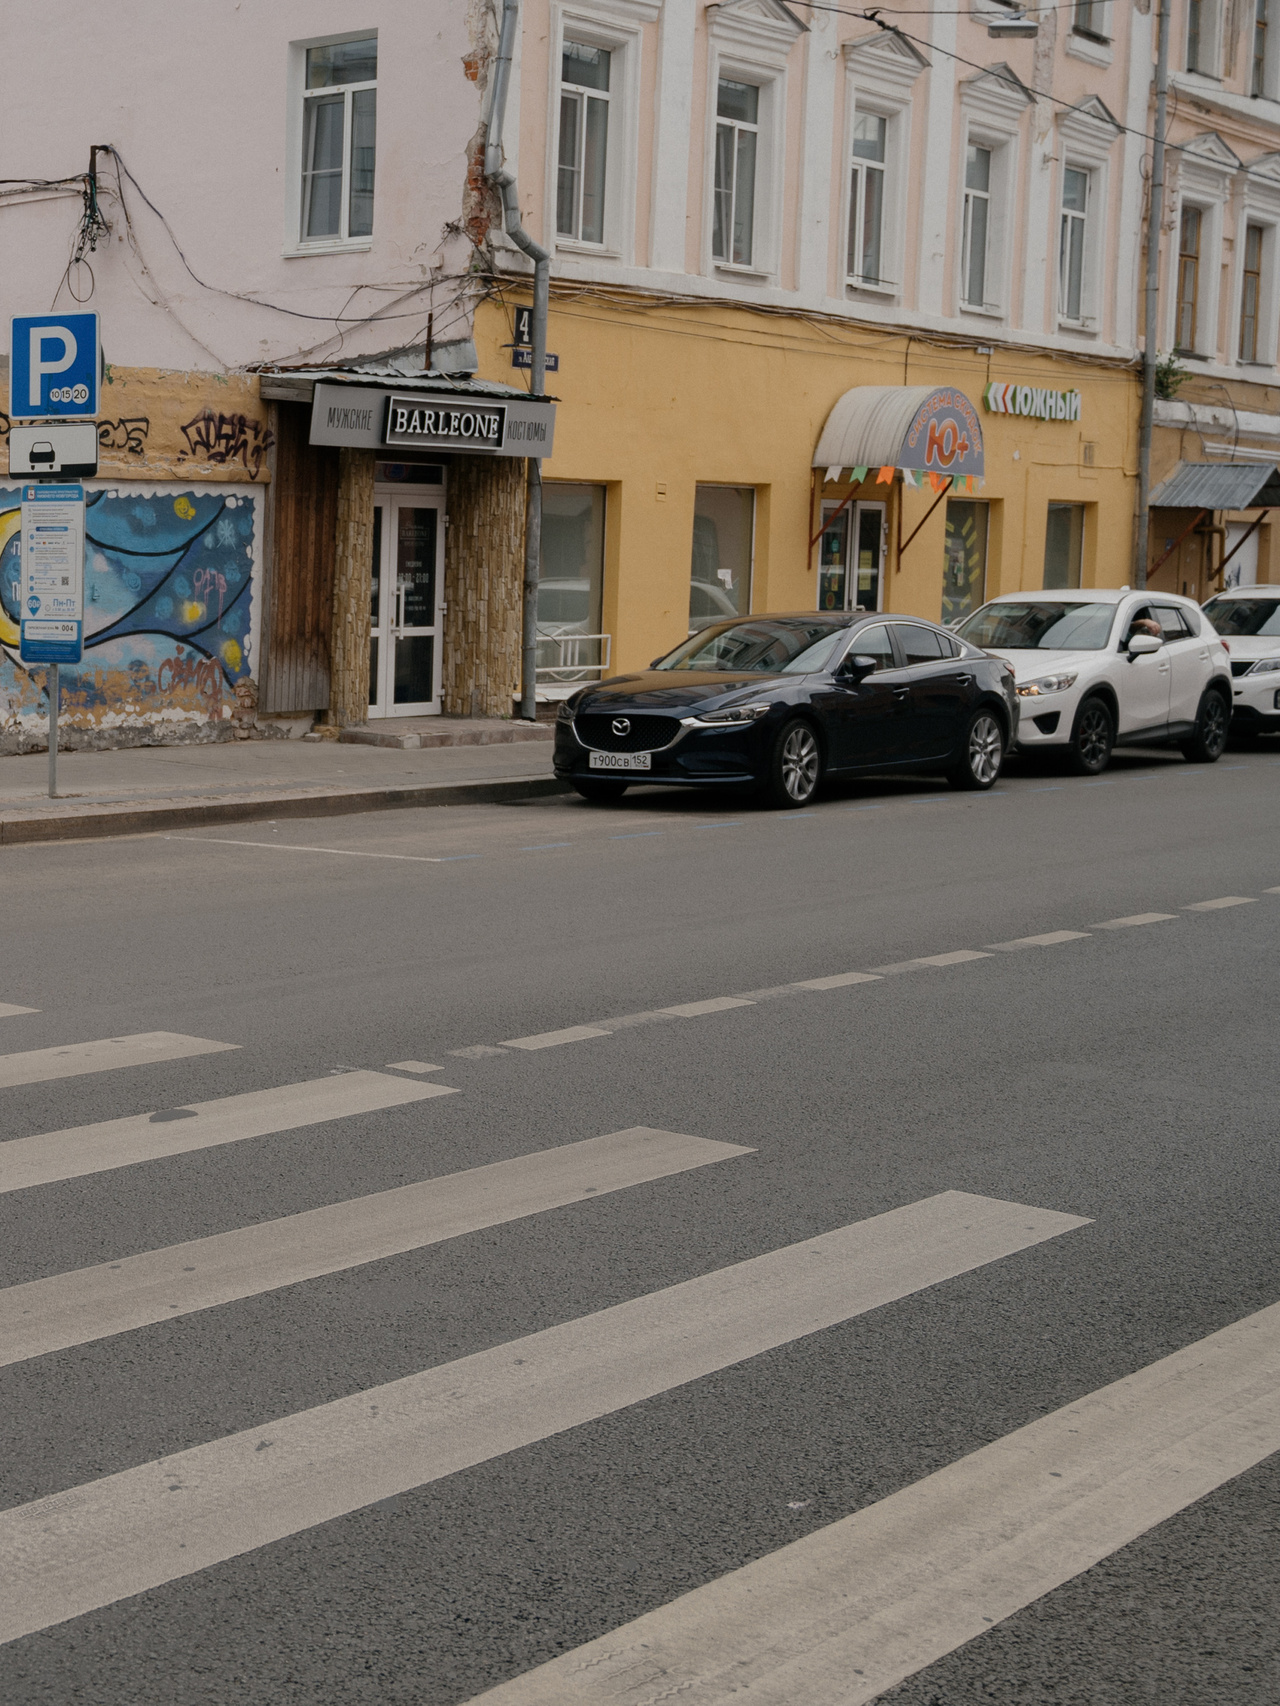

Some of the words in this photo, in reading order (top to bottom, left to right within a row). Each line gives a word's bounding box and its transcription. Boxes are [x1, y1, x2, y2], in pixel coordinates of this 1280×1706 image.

[519, 311, 529, 342] 4
[29, 325, 78, 407] P
[51, 390, 60, 399] 10
[61, 389, 71, 399] 15
[73, 388, 87, 400] 20
[1015, 385, 1081, 422] ЮЖНЫЙ
[327, 407, 373, 431] МУЖСКИЕ
[395, 408, 499, 439] BARLEONE
[507, 419, 547, 442] КОСТЮМЫ
[908, 393, 952, 448] СИСТЕМА
[953, 393, 982, 457] СКИДОК
[924, 417, 970, 468] Ю+
[61, 624, 74, 632] 004
[632, 755, 648, 764] 152
